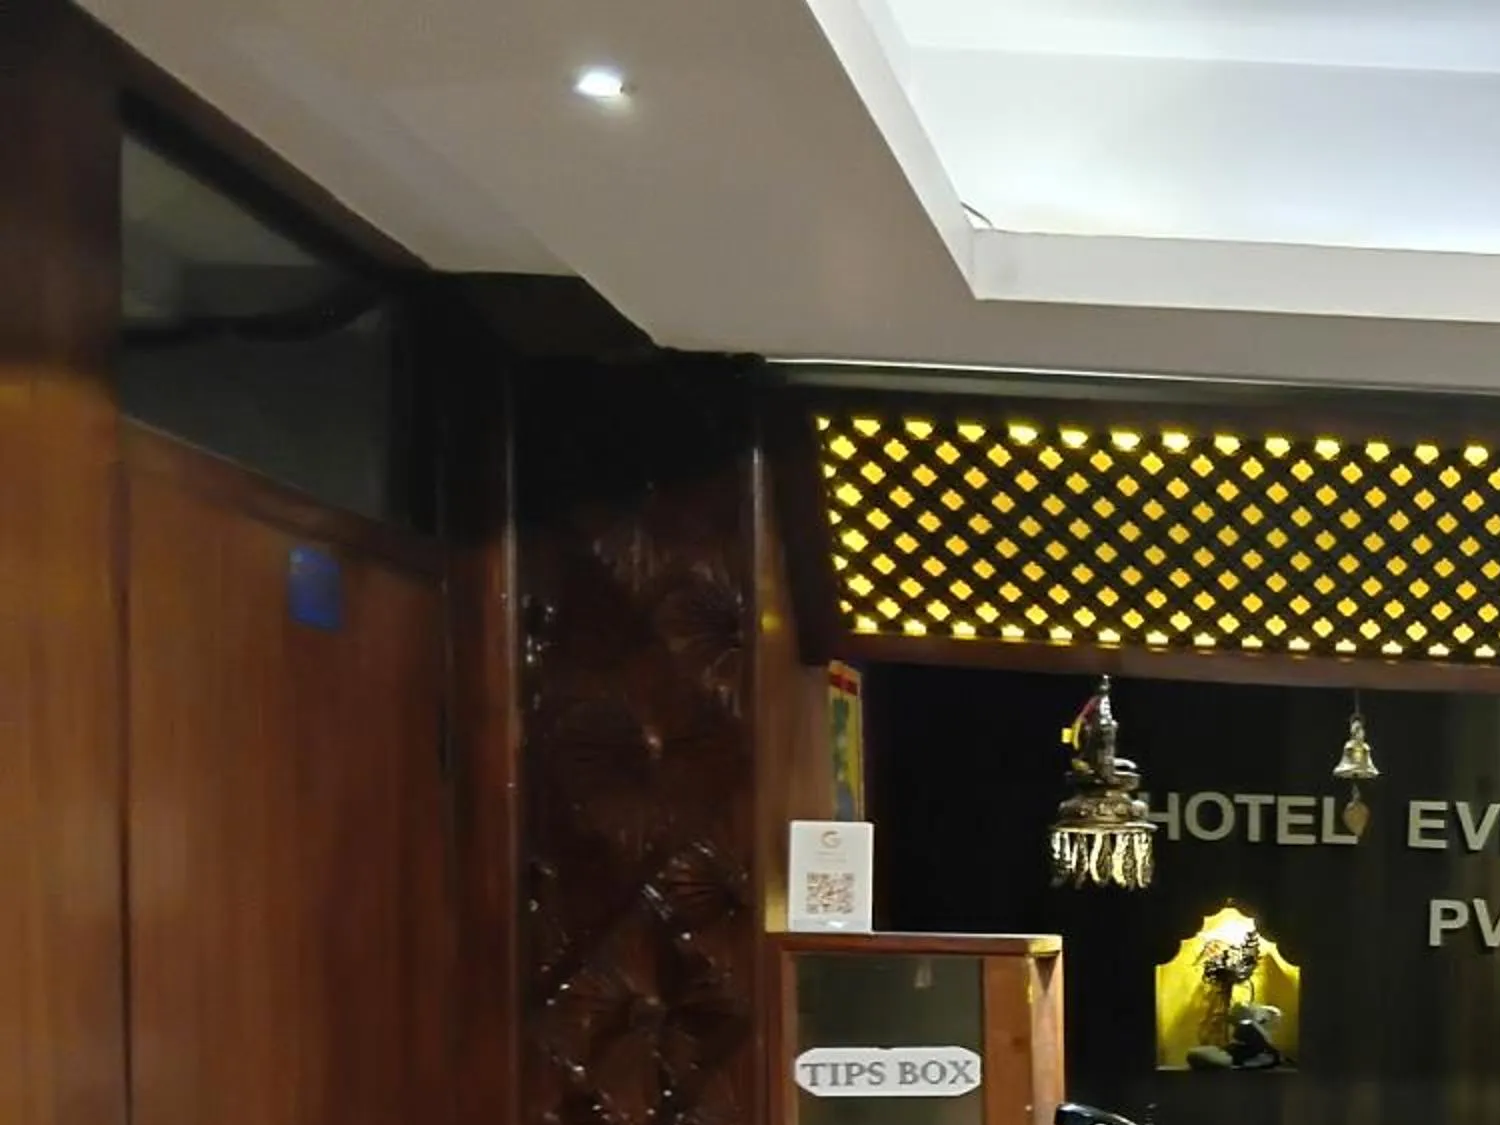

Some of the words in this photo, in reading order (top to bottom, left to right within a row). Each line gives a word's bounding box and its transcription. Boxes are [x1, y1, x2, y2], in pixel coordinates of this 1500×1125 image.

[1138, 791, 1359, 845] HOTEL
[801, 1061, 886, 1087] TIPS
[897, 1060, 975, 1085] BOX
